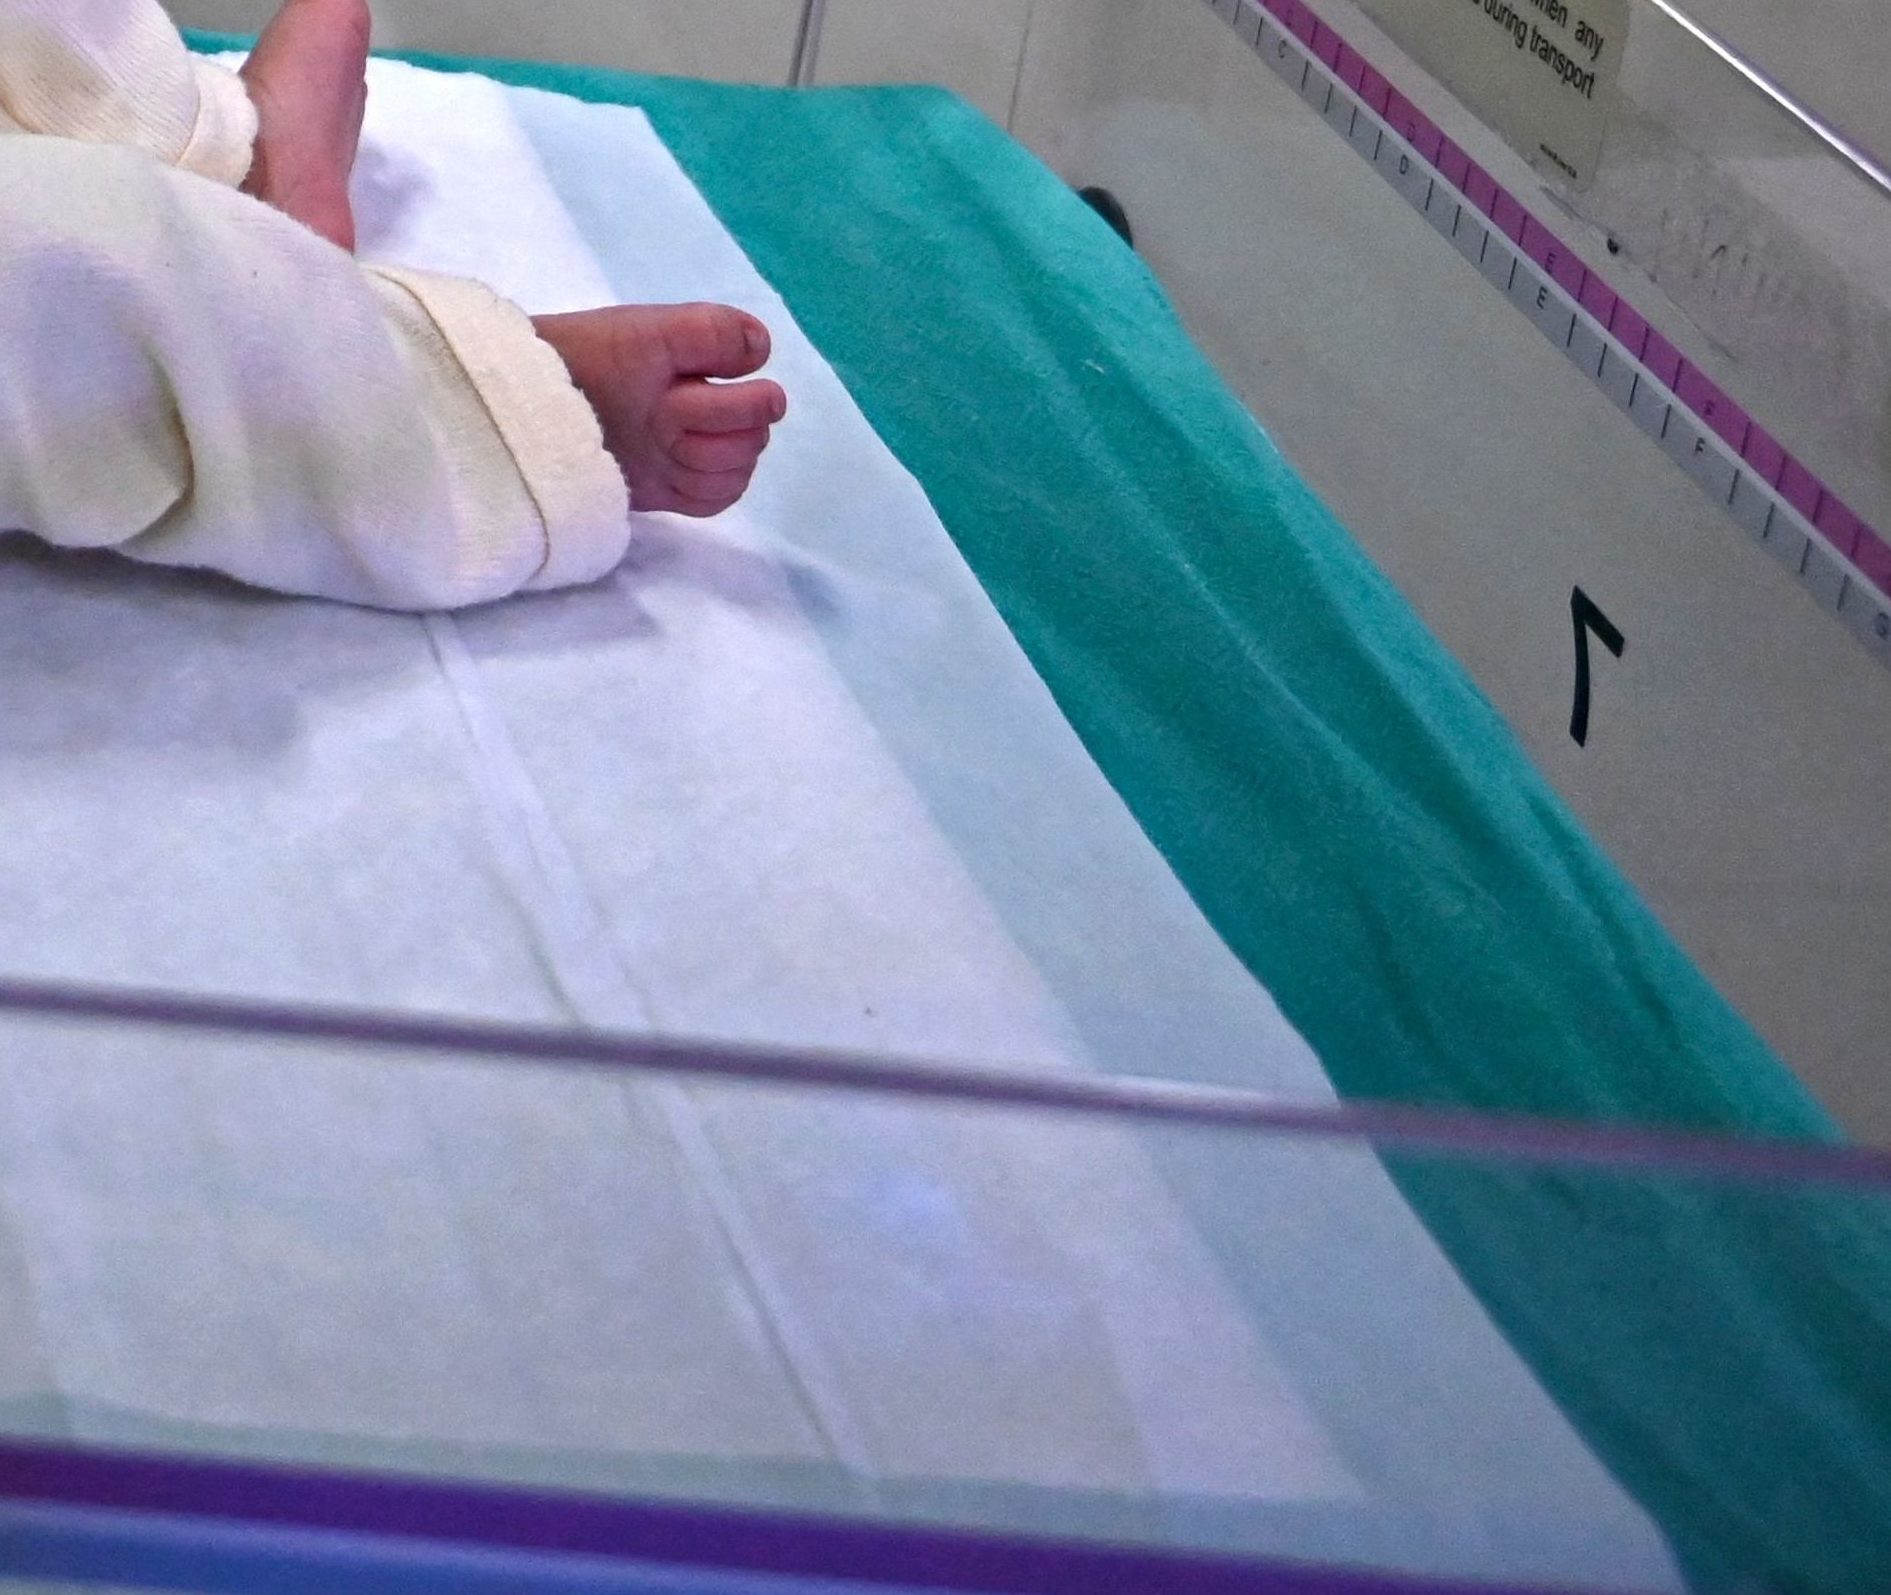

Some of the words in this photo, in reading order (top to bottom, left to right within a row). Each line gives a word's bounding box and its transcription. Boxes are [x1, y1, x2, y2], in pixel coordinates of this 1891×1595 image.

[1528, 23, 1597, 101] transport
[1573, 19, 1605, 62] any
[1277, 39, 1288, 59] C
[1398, 153, 1410, 175] D
[1535, 286, 1548, 310] E
[1694, 437, 1707, 455] F
